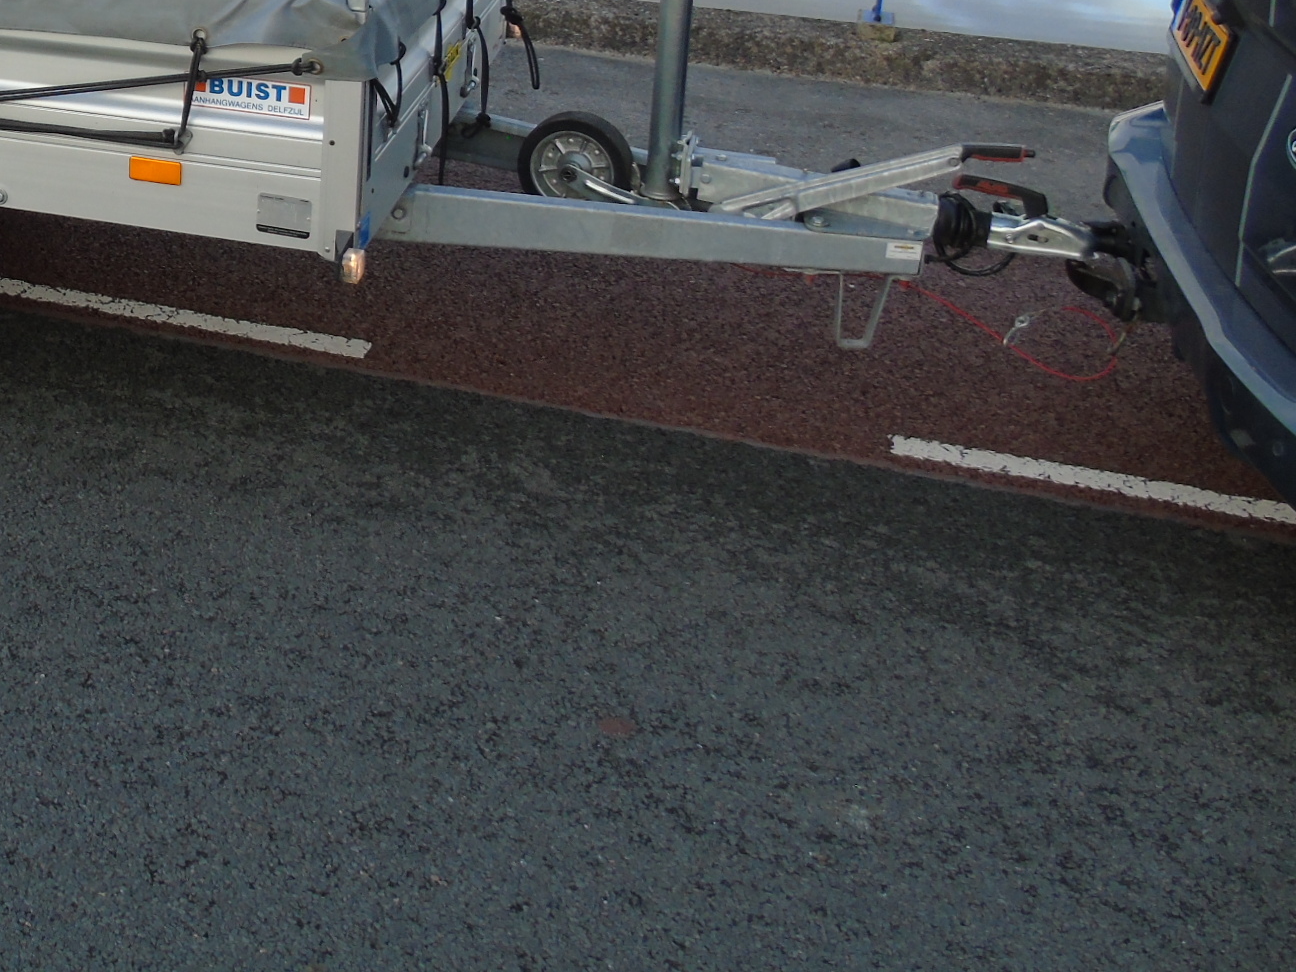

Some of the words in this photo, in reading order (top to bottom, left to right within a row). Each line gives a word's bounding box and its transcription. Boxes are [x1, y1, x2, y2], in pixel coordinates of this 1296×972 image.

[209, 77, 287, 102] BUIST
[192, 96, 264, 111] ANHANGWAGENS
[267, 104, 304, 116] DELFZIJL
